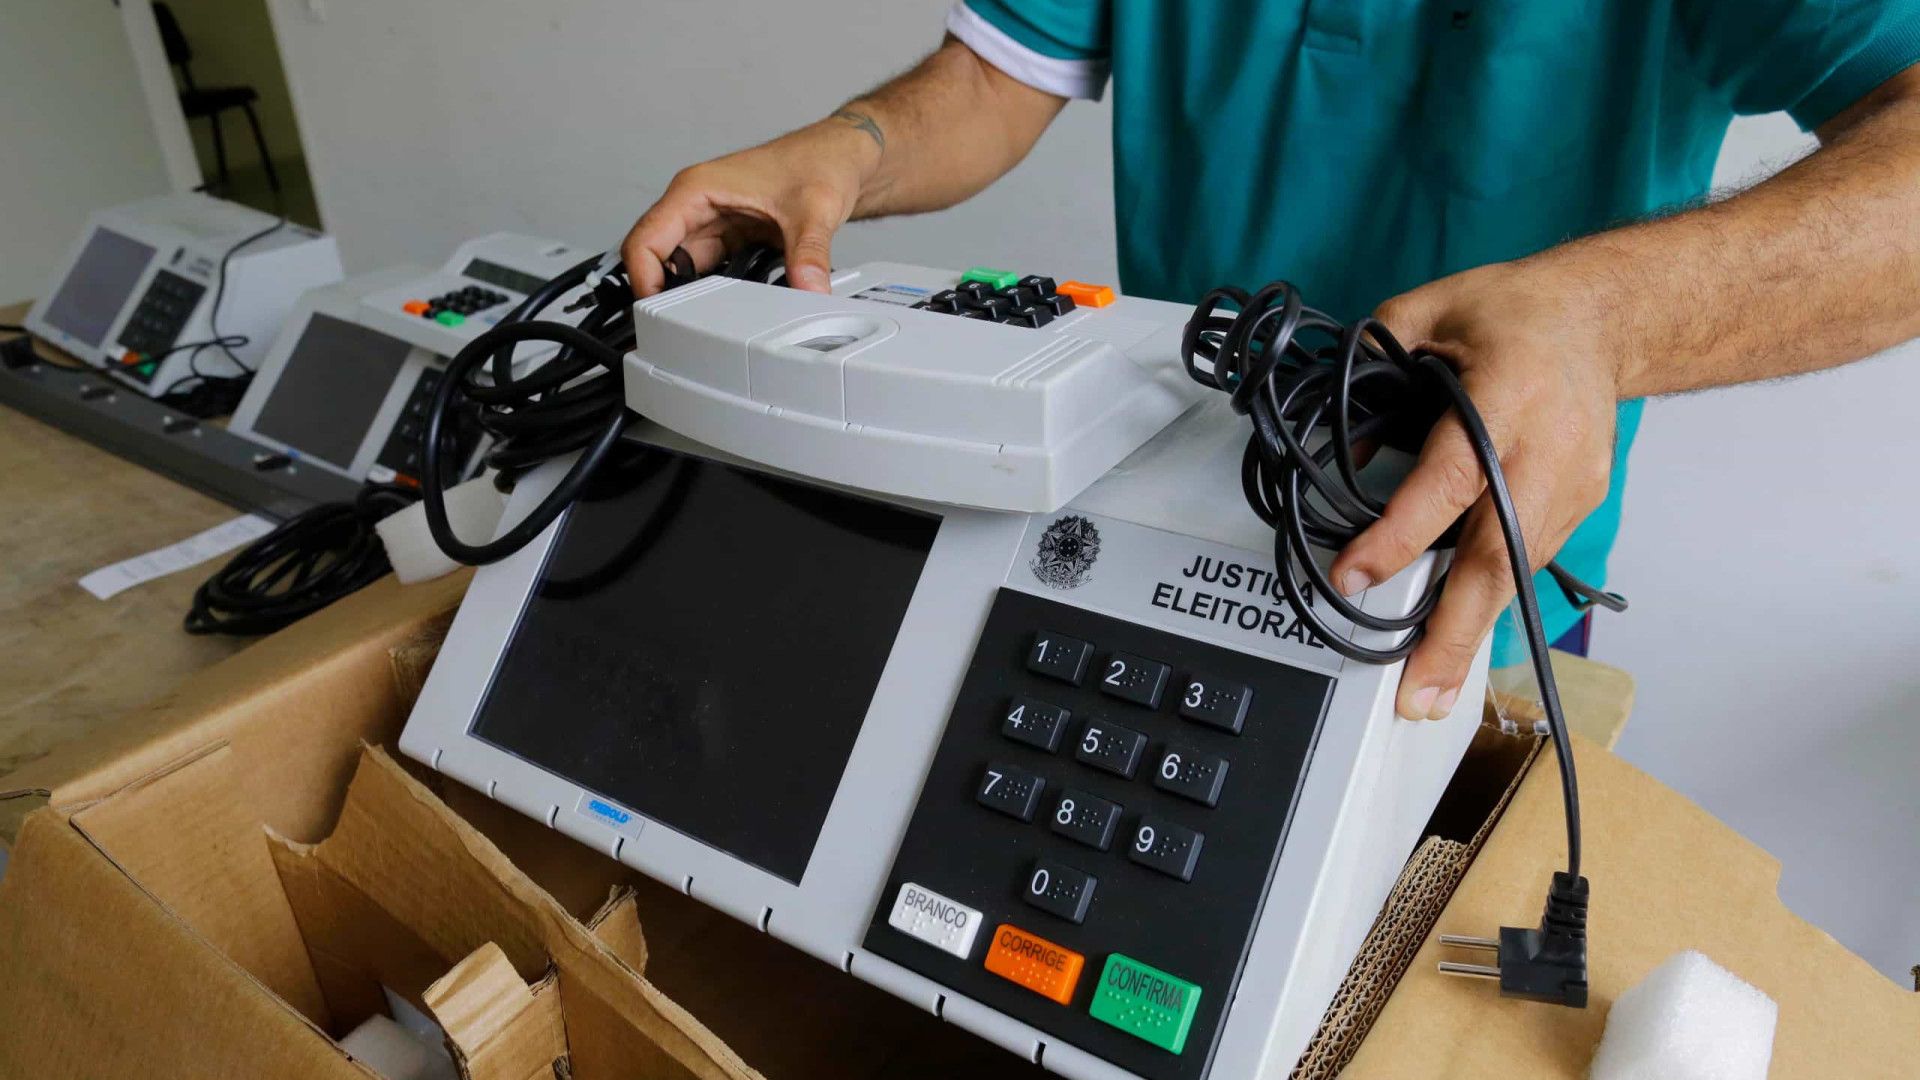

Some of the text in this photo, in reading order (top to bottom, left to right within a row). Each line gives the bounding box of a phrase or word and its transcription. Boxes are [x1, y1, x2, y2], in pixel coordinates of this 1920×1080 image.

[1151, 582, 1325, 649] ELEITORAL
[1036, 639, 1204, 708] 1 2 3
[1007, 704, 1181, 780] 4 5 6
[983, 770, 1155, 853] 7 8 9
[904, 888, 967, 929] BRANCO
[1030, 869, 1050, 895] 0
[1000, 930, 1068, 973] CORRIGE
[1106, 962, 1184, 1014] CONFIRMA
